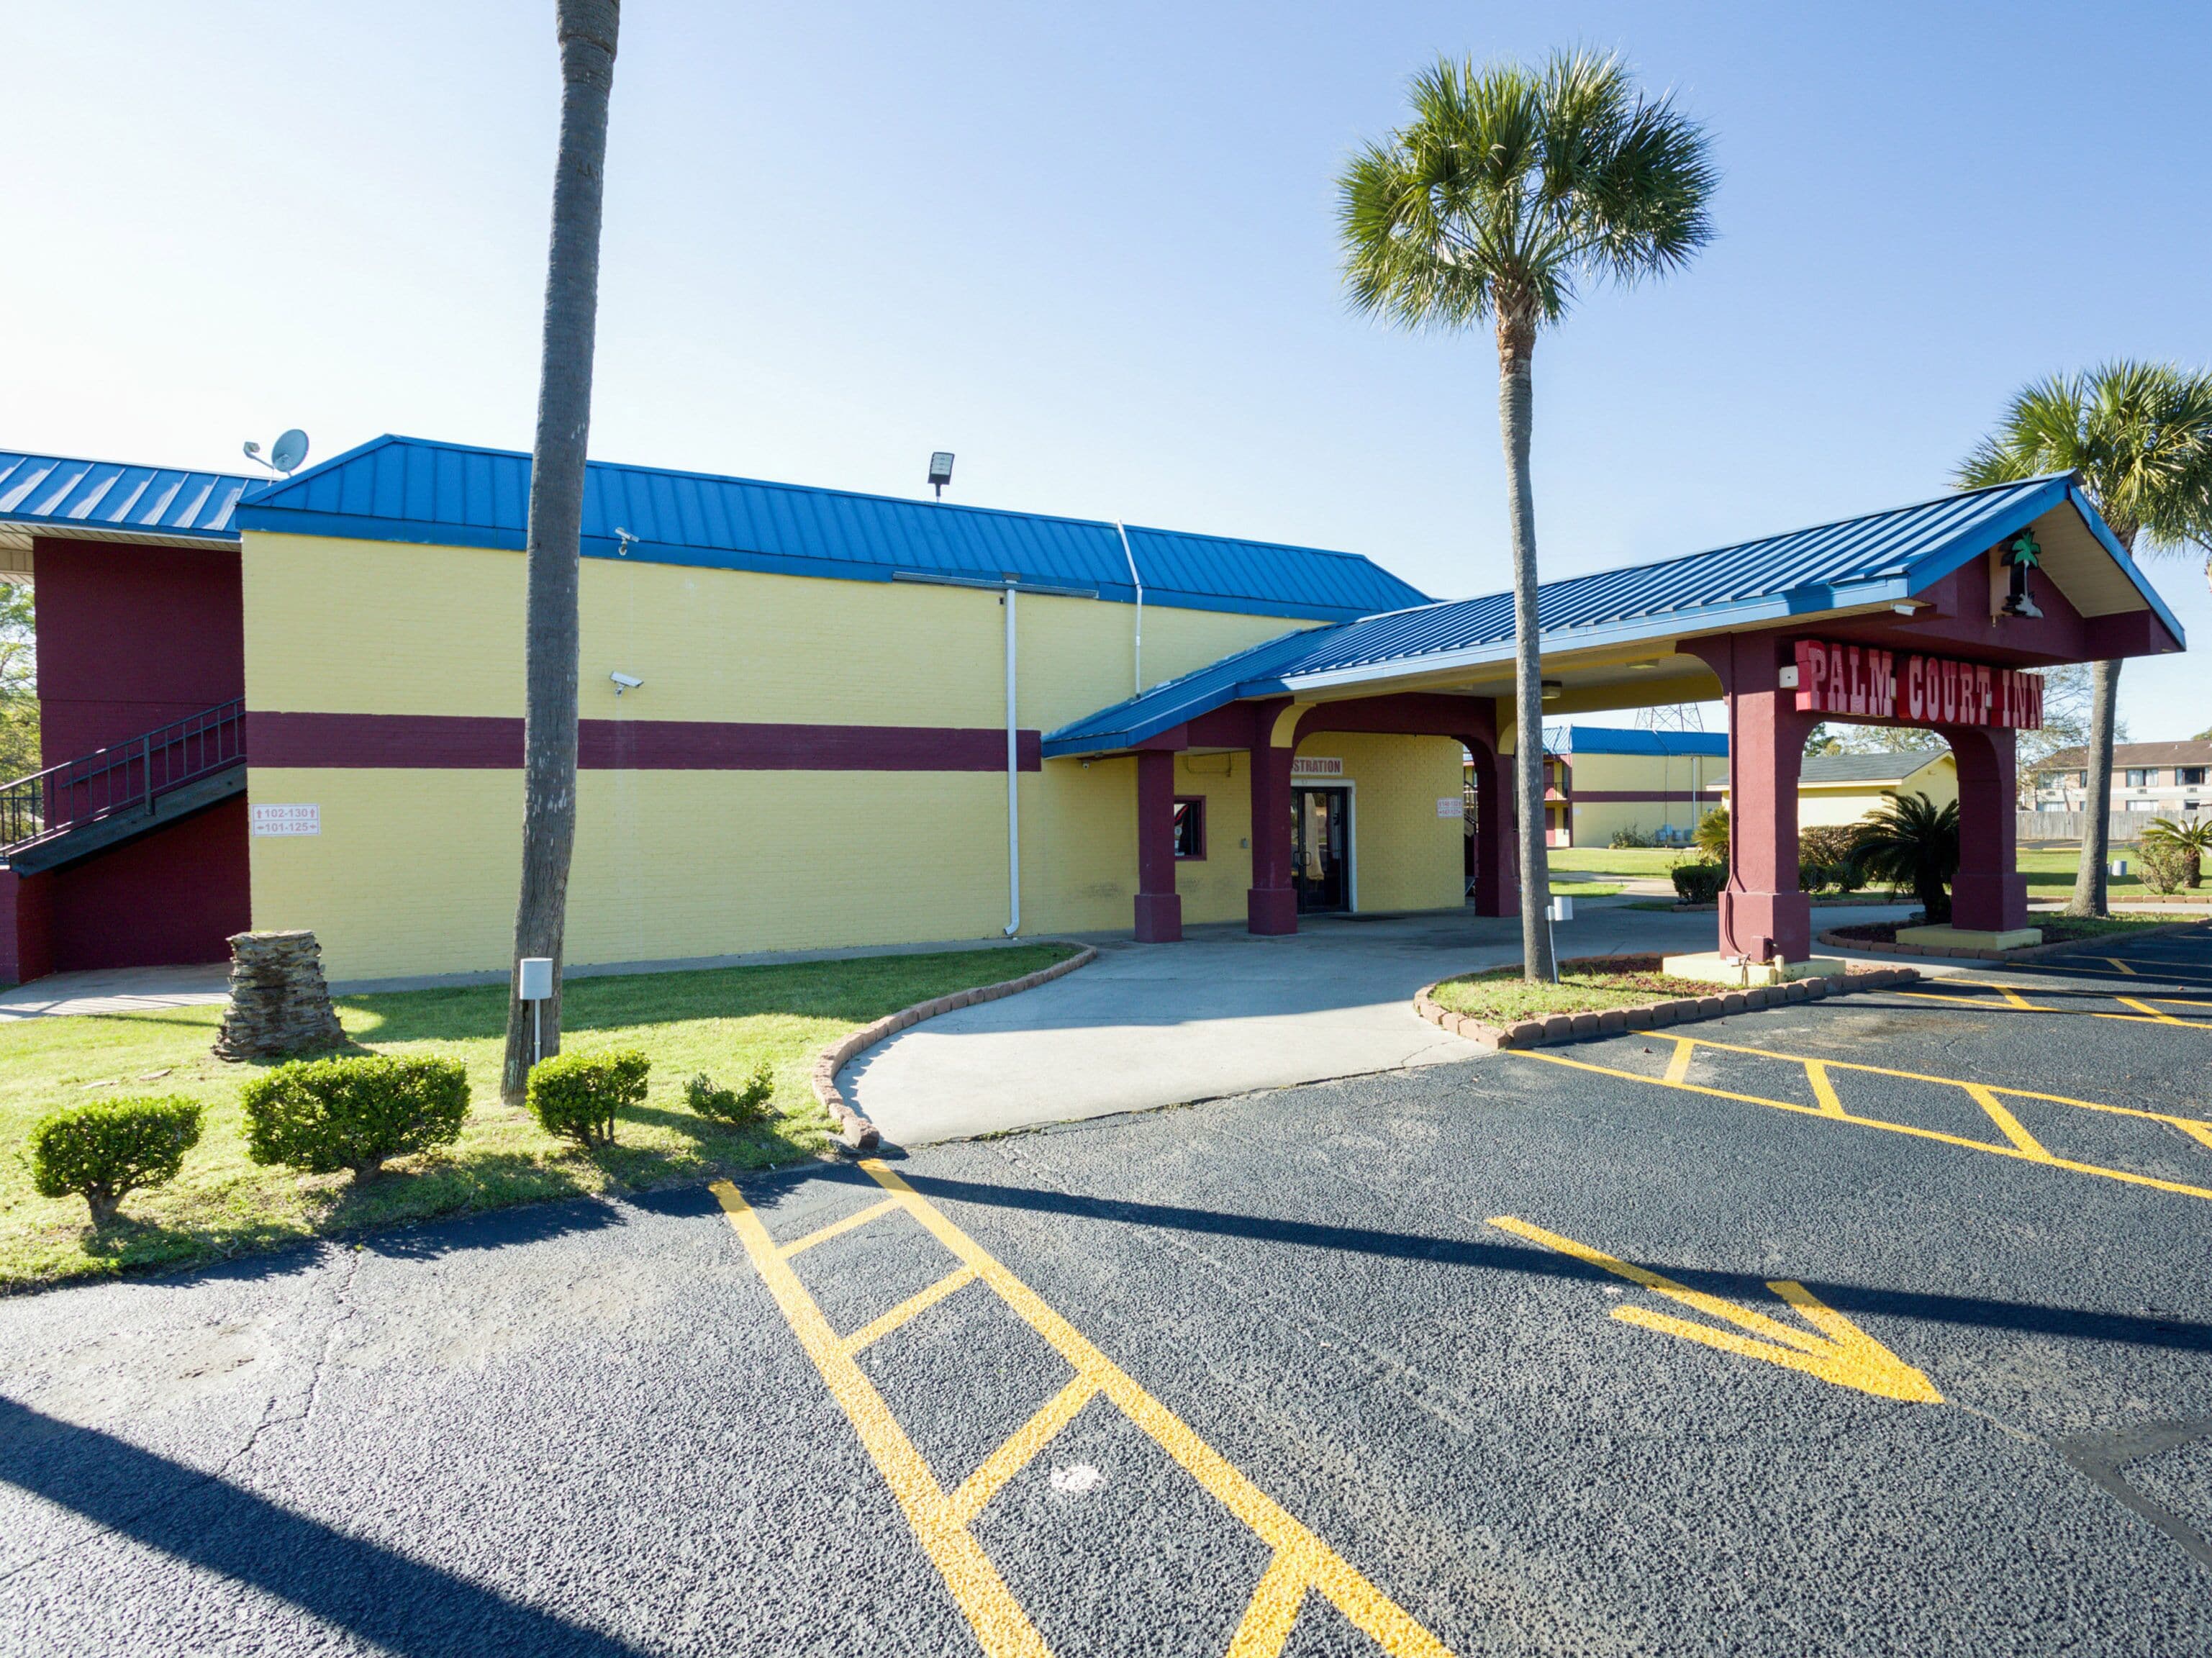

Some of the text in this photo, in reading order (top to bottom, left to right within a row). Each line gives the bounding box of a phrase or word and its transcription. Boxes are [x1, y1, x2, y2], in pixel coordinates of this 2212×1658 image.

[1808, 640, 2044, 730] PALM COURT INN
[1292, 759, 1341, 773] STRATION
[265, 808, 308, 818] 102-130
[265, 823, 308, 832] 101-125
